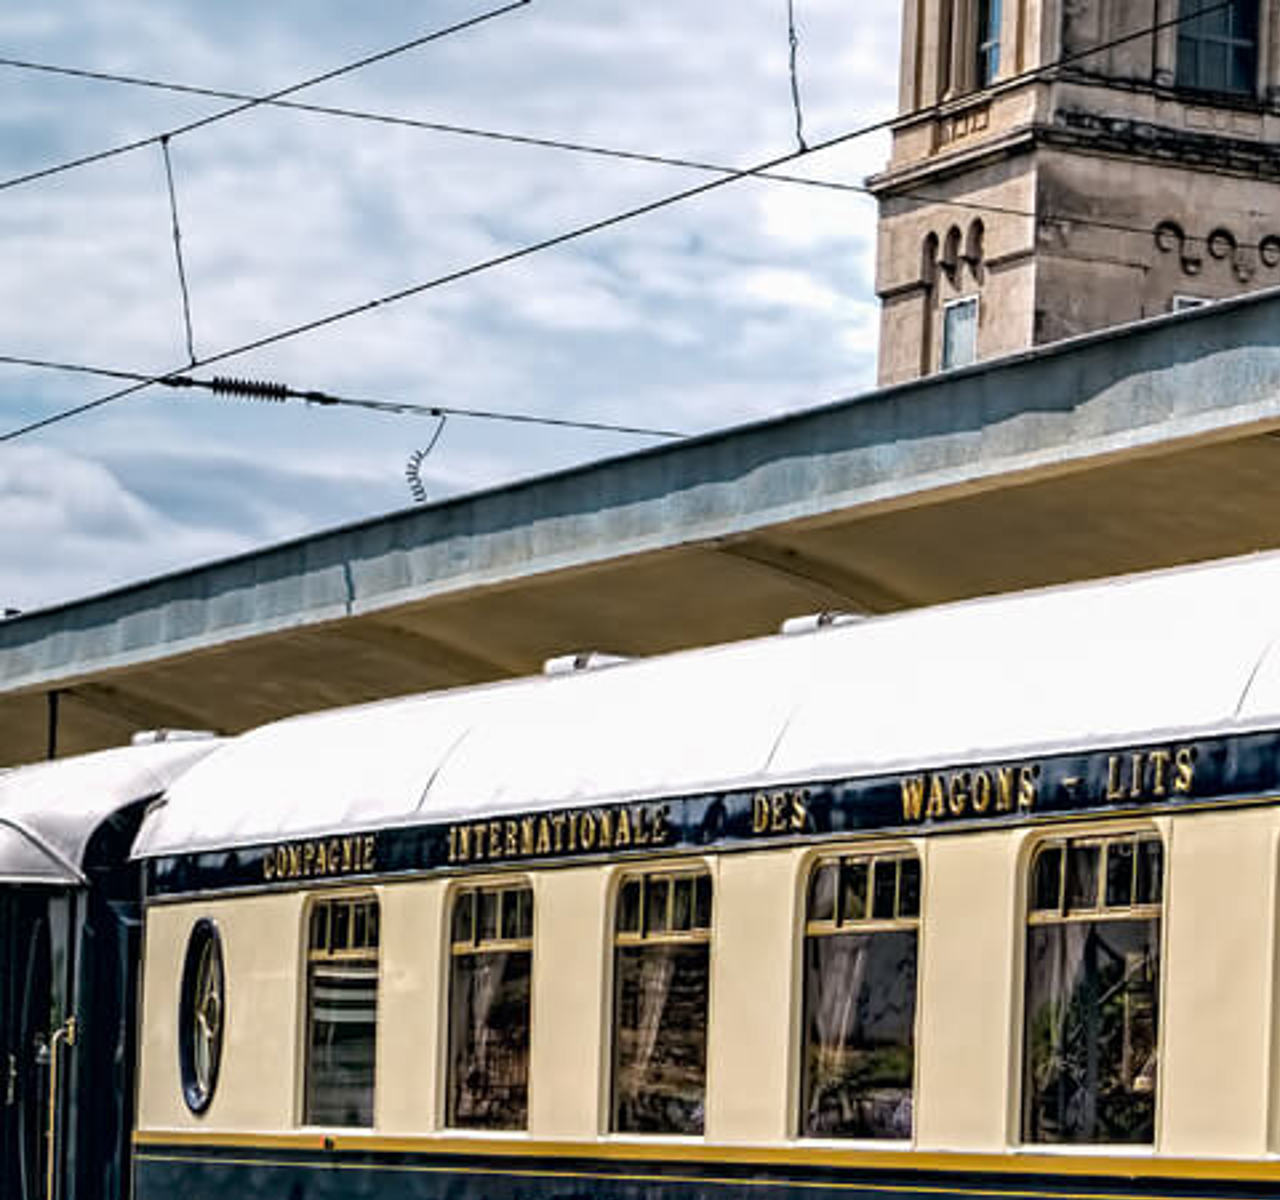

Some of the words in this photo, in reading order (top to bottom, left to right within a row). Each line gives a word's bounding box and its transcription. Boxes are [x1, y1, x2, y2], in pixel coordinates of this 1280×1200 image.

[263, 834, 376, 879] COMPAGNIE
[448, 803, 670, 863] INTERNATIONALE
[752, 788, 808, 834] DES
[903, 766, 1037, 820] WAGONS
[1106, 748, 1196, 800] LITS
